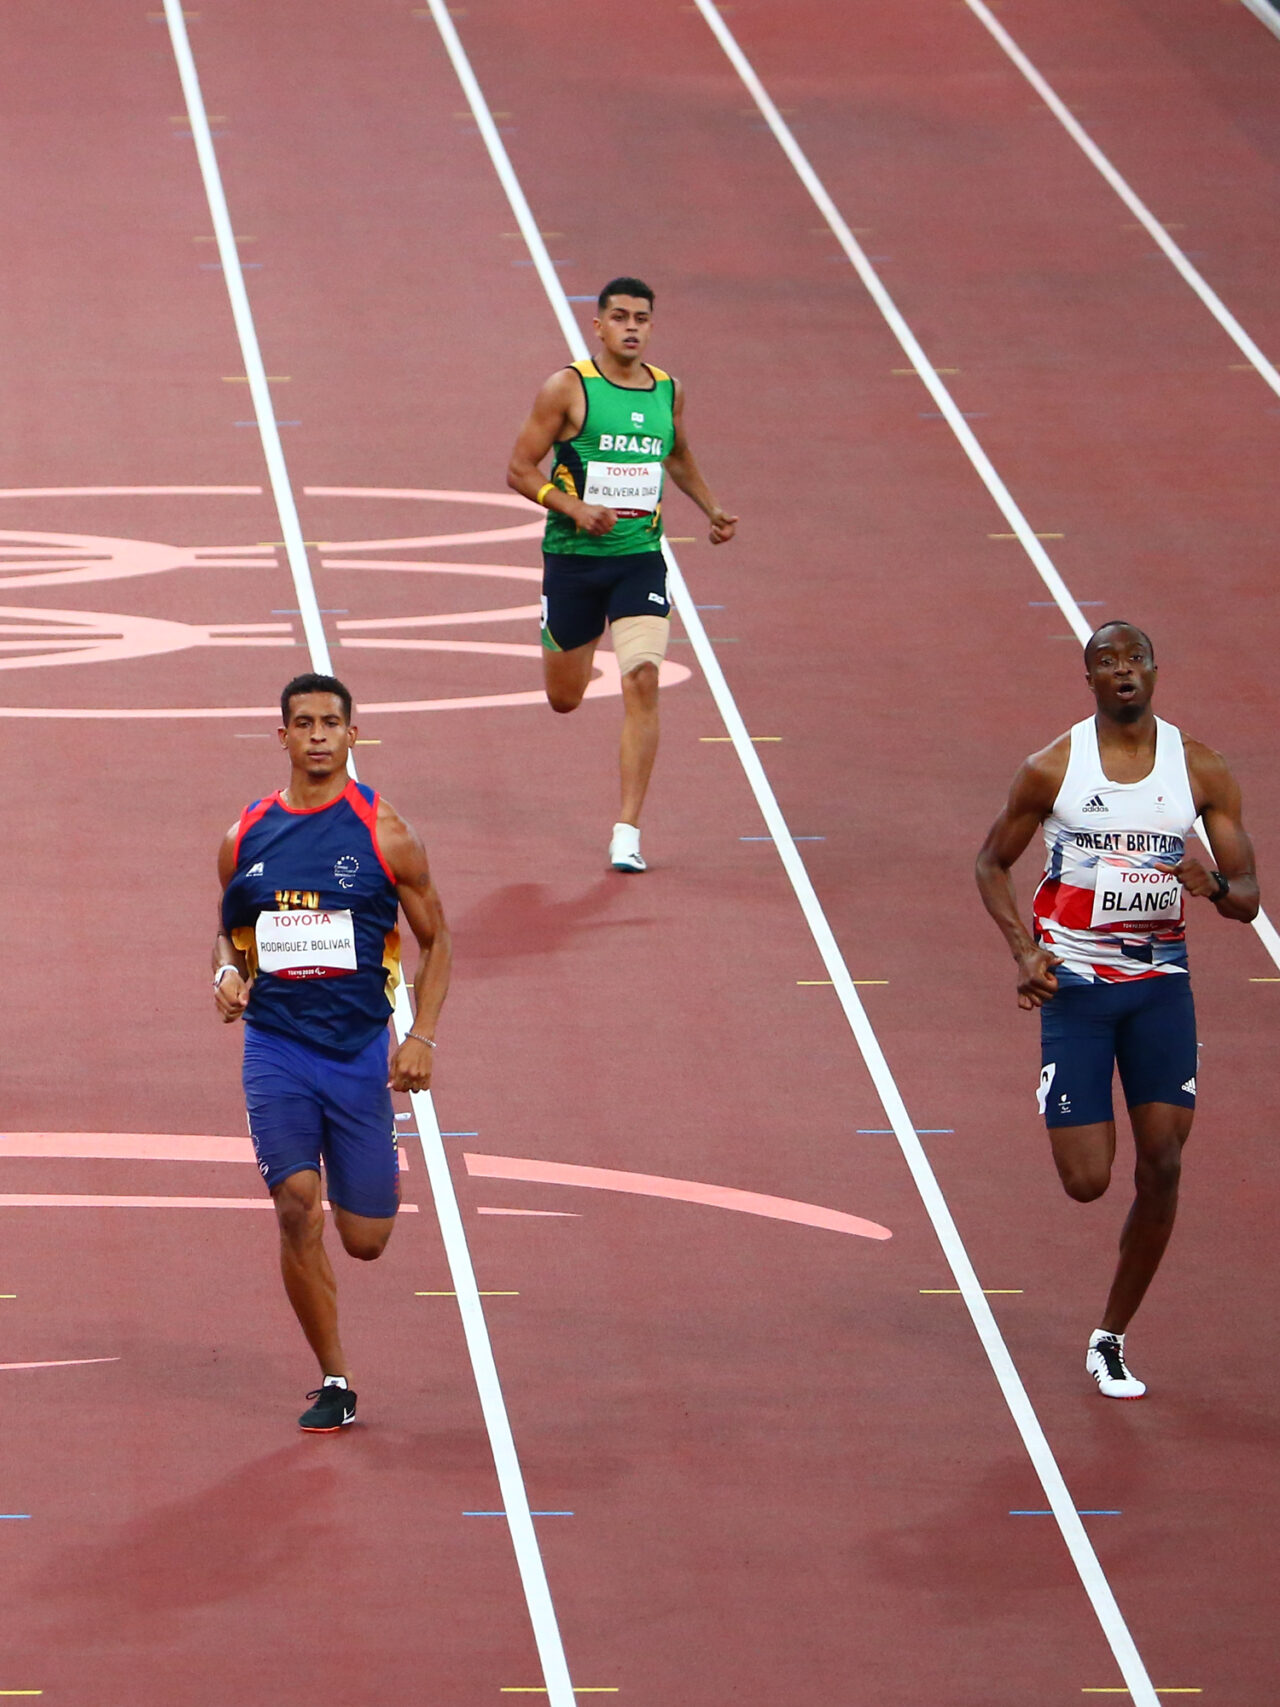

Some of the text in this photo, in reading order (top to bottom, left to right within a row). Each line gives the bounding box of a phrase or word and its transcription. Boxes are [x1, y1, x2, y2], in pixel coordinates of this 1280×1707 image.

[606, 466, 649, 476] TOYOTA
[588, 486, 599, 494] de
[602, 486, 639, 497] OLIVEIRA
[1082, 805, 1109, 813] adidas
[1074, 832, 1122, 851] GREAT
[1120, 872, 1173, 884] TOYOTA
[274, 890, 320, 911] VEN
[1101, 887, 1178, 912] BLANGO
[273, 913, 331, 927] TOYOTA
[260, 938, 351, 953] RODRIGUEZ BOLIVAR
